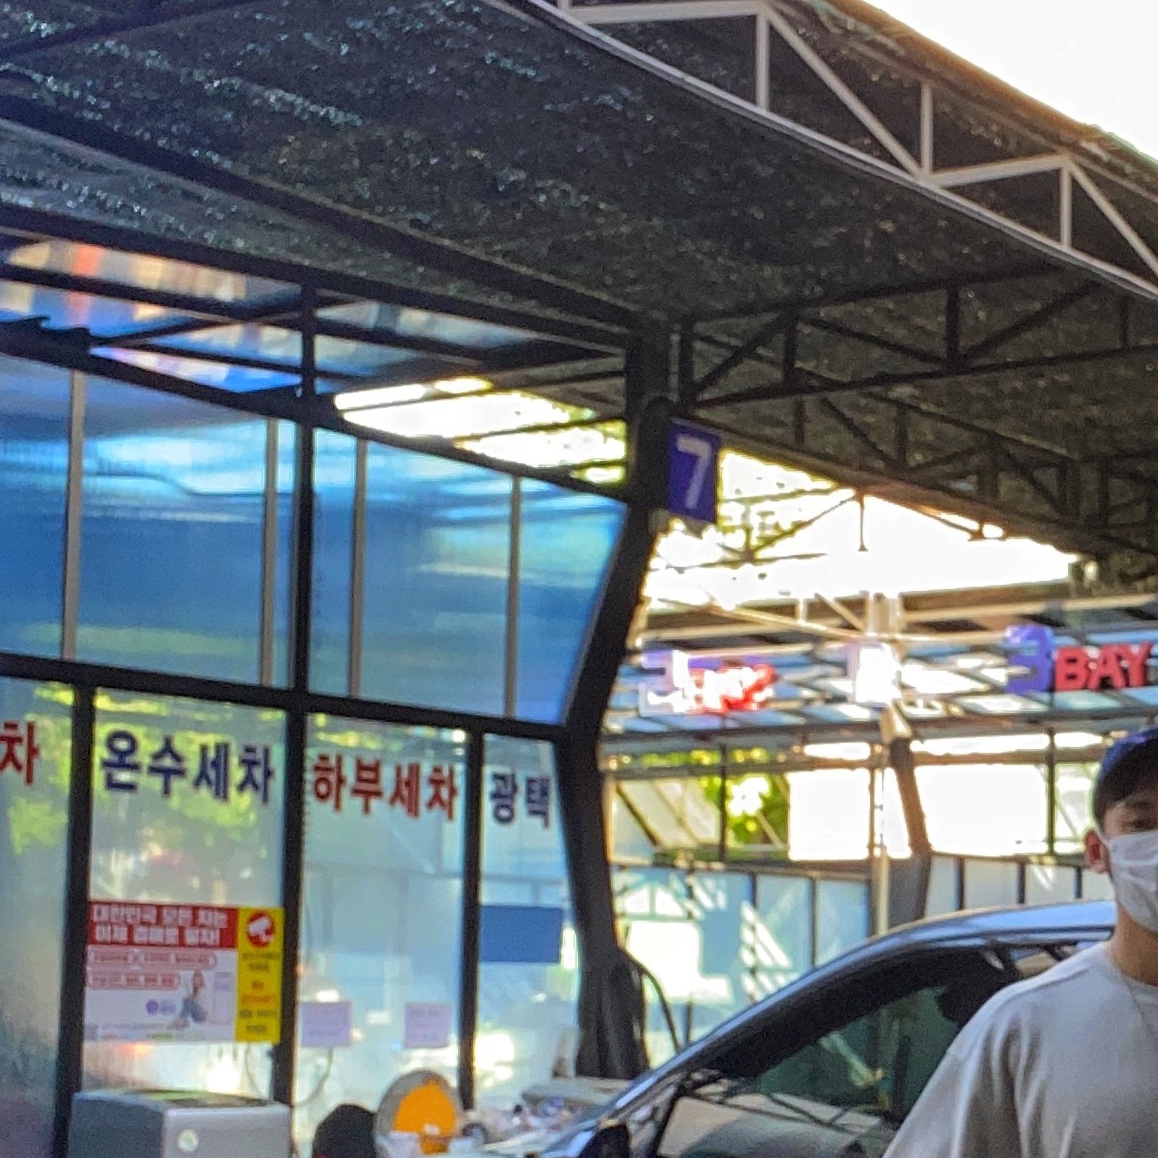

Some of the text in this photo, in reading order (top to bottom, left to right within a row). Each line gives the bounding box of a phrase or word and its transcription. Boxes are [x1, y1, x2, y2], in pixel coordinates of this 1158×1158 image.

[676, 434, 711, 510] 7
[1003, 625, 1153, 693] 3 BAY
[103, 730, 275, 805] 온수세차
[313, 755, 458, 821] 하부세차
[490, 772, 550, 828] 광택
